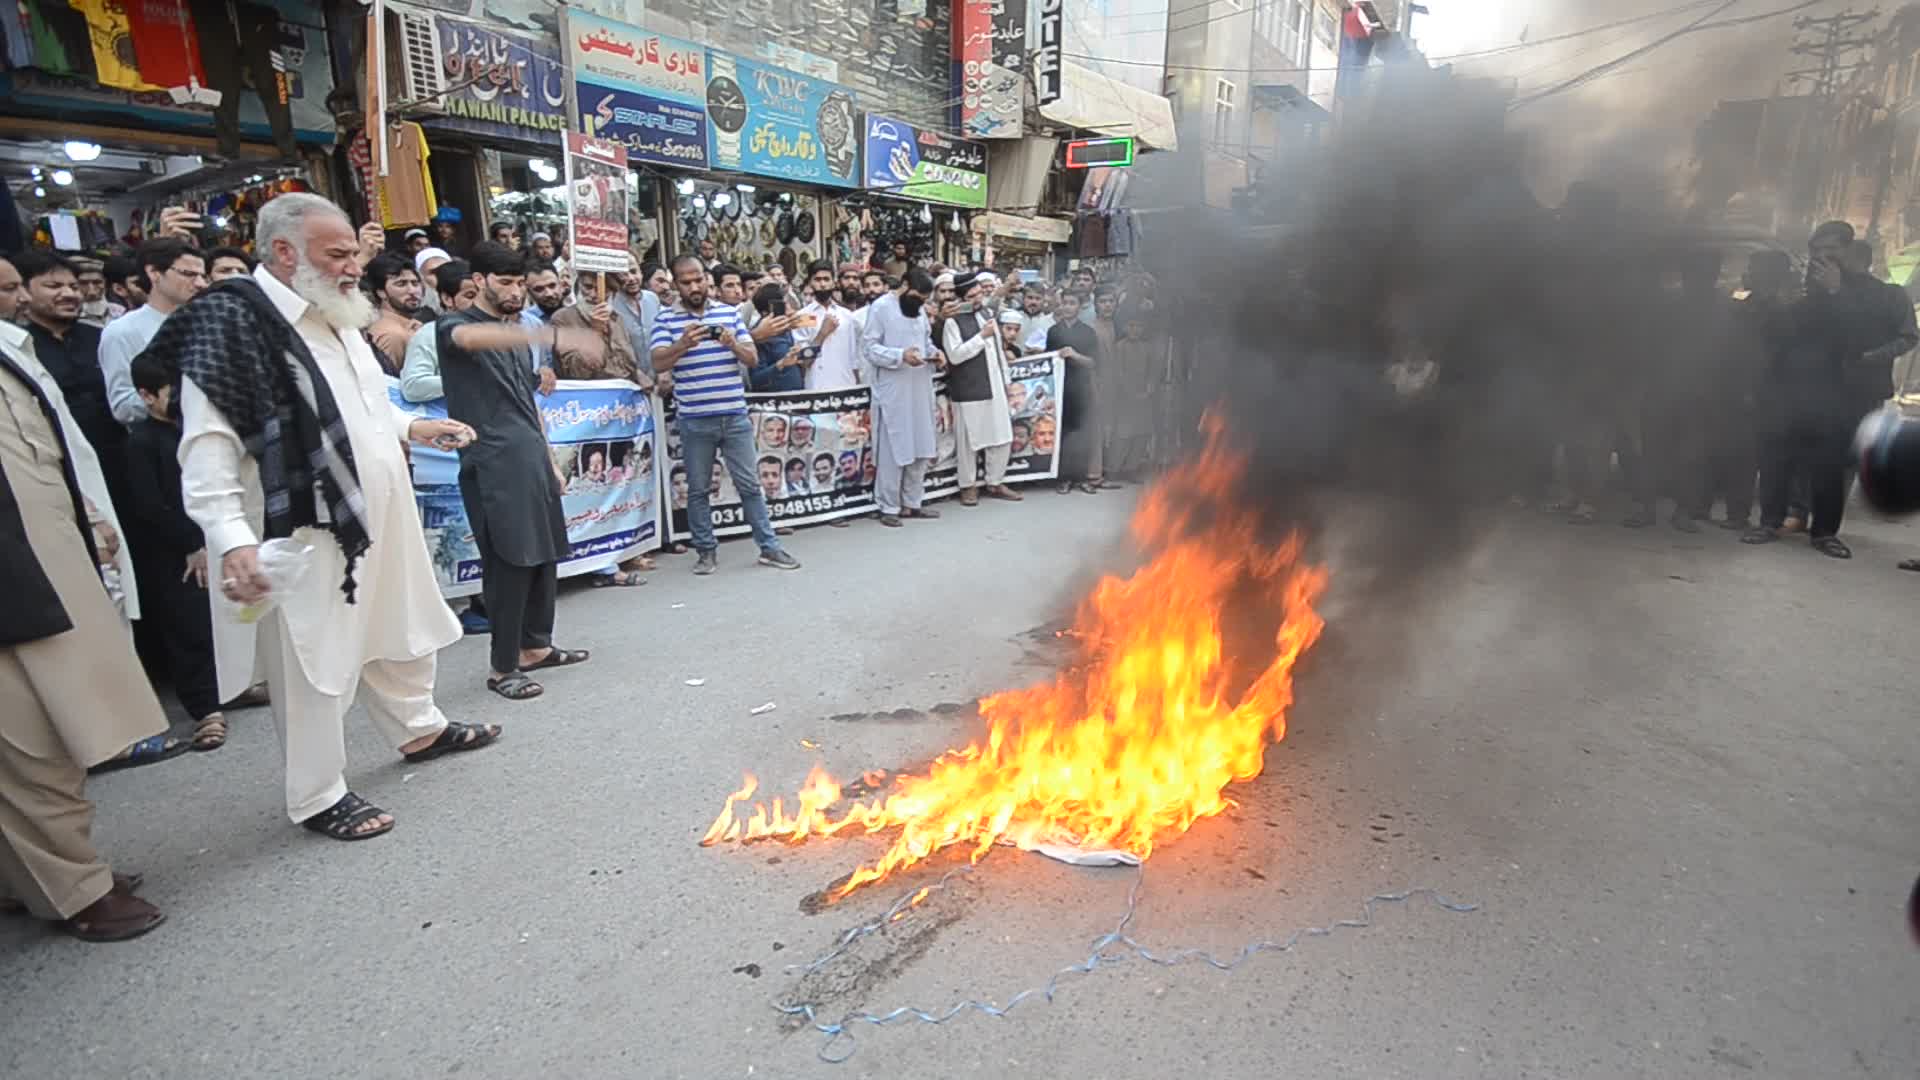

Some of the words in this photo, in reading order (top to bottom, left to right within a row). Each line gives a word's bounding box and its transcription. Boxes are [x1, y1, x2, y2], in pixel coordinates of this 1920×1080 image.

[664, 50, 700, 76] قاری
[510, 107, 568, 130] PALACE
[711, 507, 745, 525] 031
